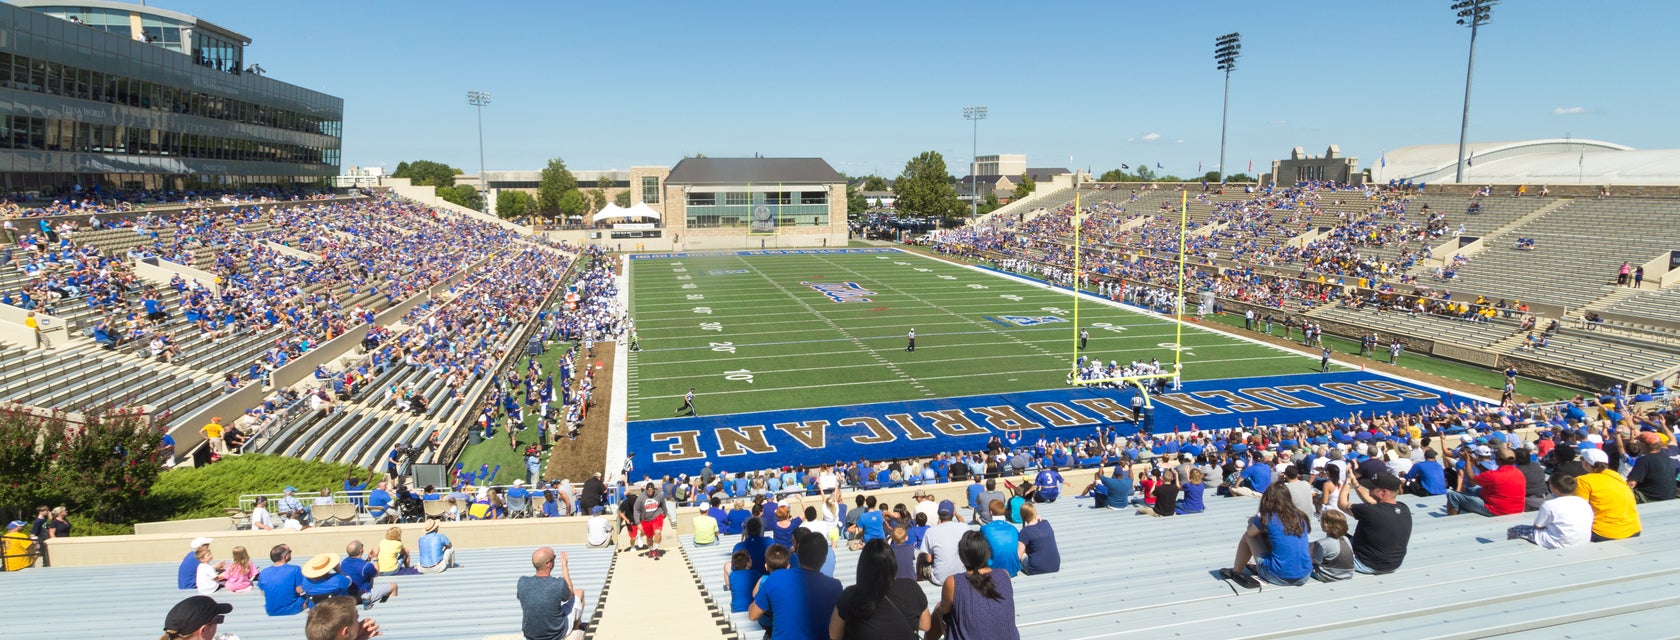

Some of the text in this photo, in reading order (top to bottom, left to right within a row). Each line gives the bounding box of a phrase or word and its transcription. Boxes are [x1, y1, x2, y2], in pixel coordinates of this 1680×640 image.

[708, 341, 736, 352] 20
[723, 368, 754, 381] 10
[650, 379, 1442, 463] GOLDEN HURRICANE
[1045, 472, 1053, 484] 3
